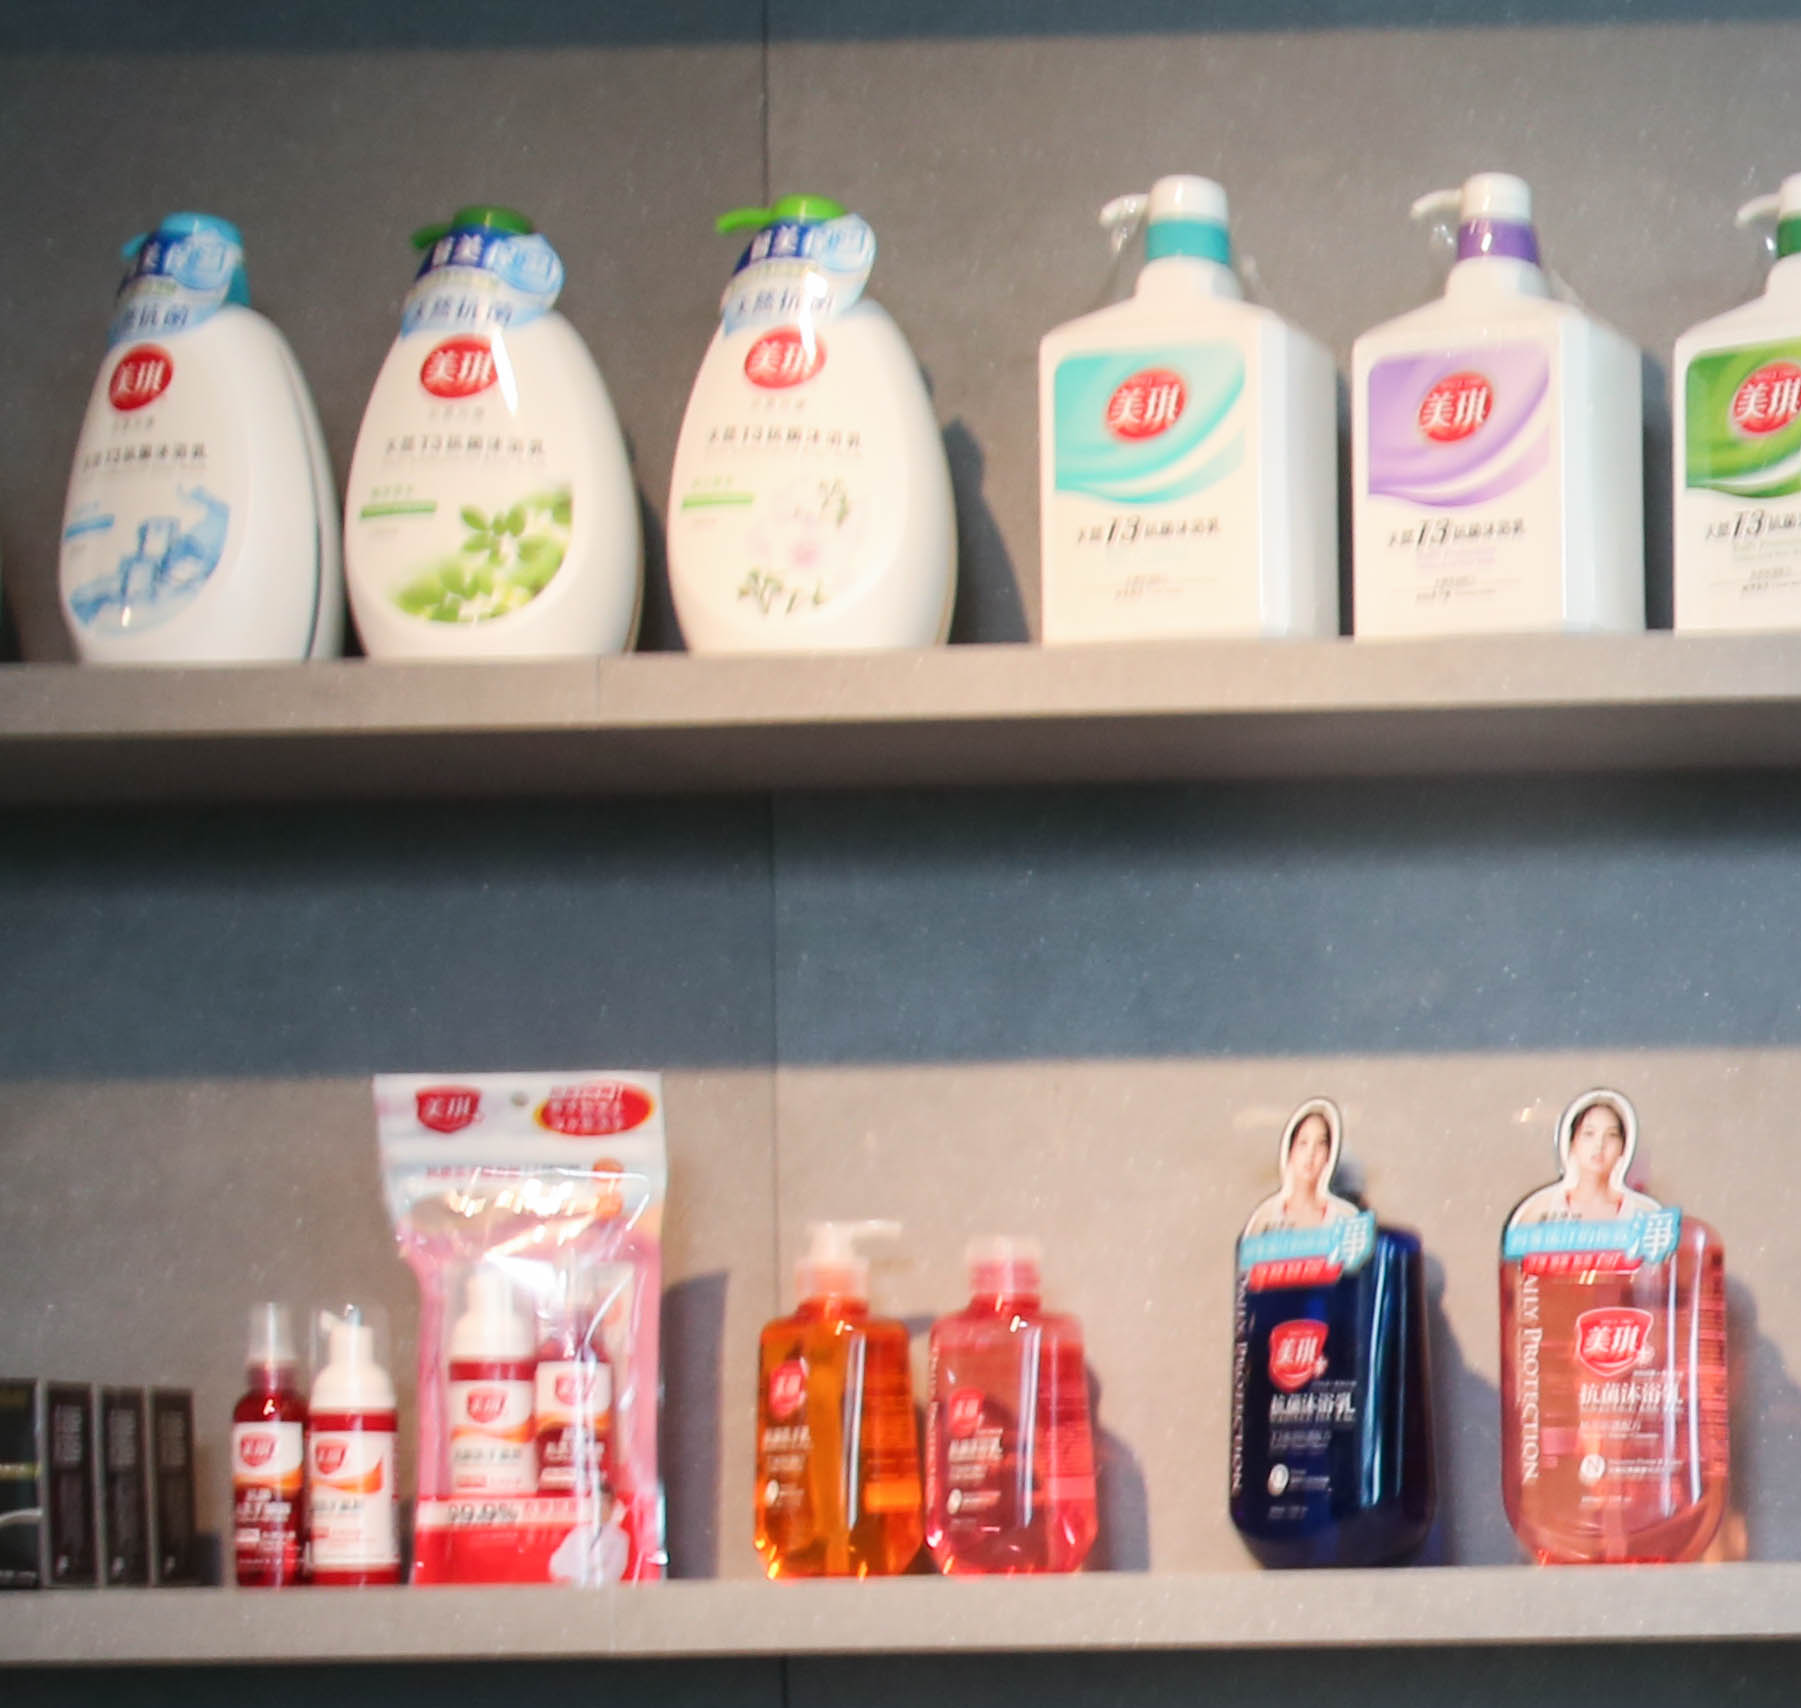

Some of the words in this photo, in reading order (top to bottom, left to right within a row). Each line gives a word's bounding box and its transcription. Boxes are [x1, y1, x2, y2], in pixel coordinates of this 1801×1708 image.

[427, 348, 492, 383] 美琪
[750, 342, 815, 374] 美琪
[1108, 384, 1180, 424] 美琪
[1420, 387, 1489, 428] 美琪
[1734, 378, 1801, 422] 美琪
[1279, 1338, 1317, 1365] 美琪
[1584, 1325, 1639, 1353] 美琪
[1521, 1330, 1542, 1483] PROTECTION
